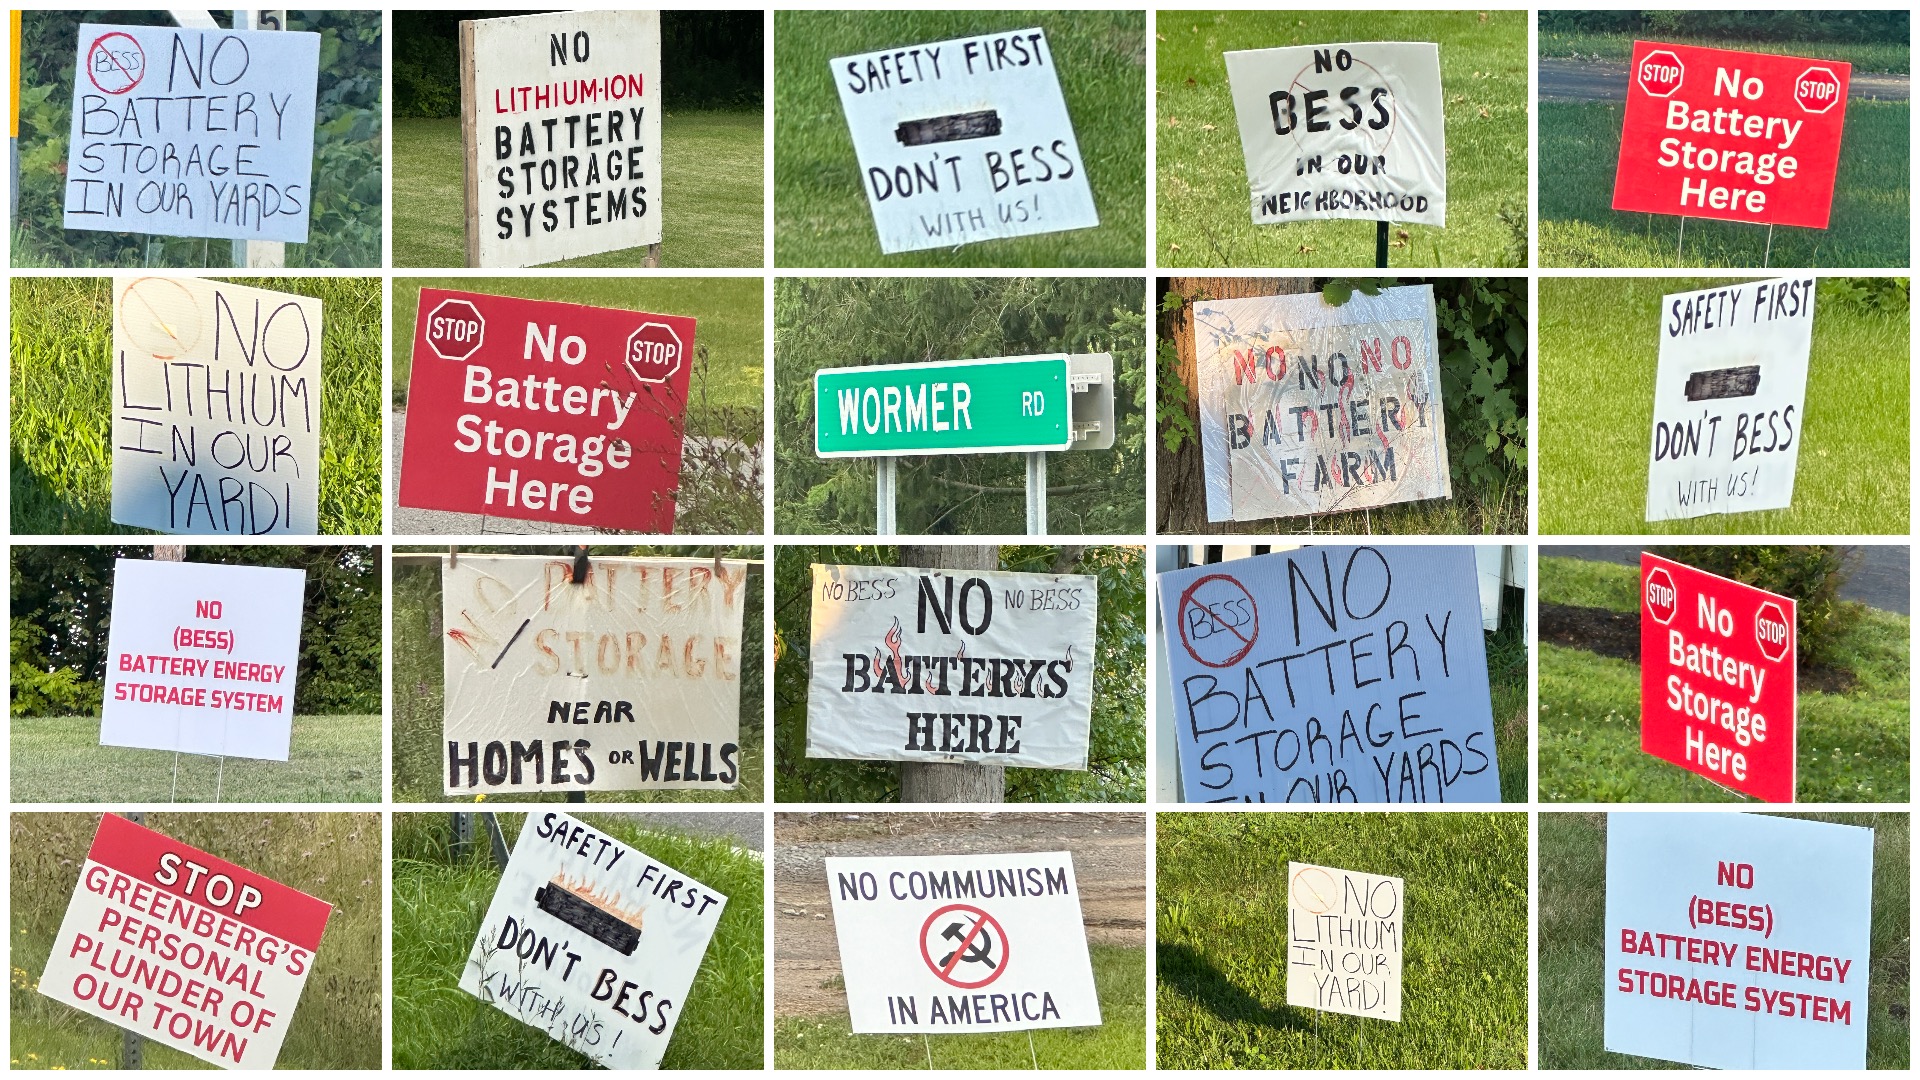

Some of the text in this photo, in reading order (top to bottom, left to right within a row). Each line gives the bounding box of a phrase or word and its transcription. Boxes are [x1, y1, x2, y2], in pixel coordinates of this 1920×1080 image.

[95, 49, 141, 74] BESS
[168, 33, 249, 91] NO
[550, 31, 590, 67] NO
[846, 33, 1044, 94] SAFETY FIRST
[1313, 49, 1353, 75] NO
[1643, 62, 1679, 84] STOP
[1713, 66, 1764, 101] No
[1799, 79, 1835, 100] STOP
[81, 94, 293, 140] BATTERY
[495, 108, 645, 160] BATTERY
[1268, 87, 1393, 136] BESS
[1665, 101, 1803, 150] Battery
[80, 144, 269, 178] STORAGE
[497, 147, 645, 200] STORAGE
[868, 139, 1076, 202] DON'T BESS
[1296, 154, 1387, 176] IN OUR
[1657, 138, 1798, 186] Storage
[67, 179, 301, 231] IN OUR YARDS
[496, 187, 648, 241] SYSTEMS
[919, 199, 1042, 239] WITH US!
[1260, 190, 1429, 216] NEIGHBORHOOD
[1680, 176, 1766, 213] Here
[214, 290, 310, 373] NO
[432, 317, 479, 343] STOP
[1668, 278, 1814, 338] SAFETY FIRST
[522, 321, 587, 367] No
[632, 338, 676, 366] STOP
[1233, 335, 1412, 391] NO NO NO
[120, 350, 311, 433] LITHIUM
[463, 365, 637, 431] Battery
[837, 379, 1045, 437] WORMER RD
[454, 413, 632, 477] Storage
[1228, 392, 1430, 450] BATTERY
[1655, 404, 1795, 462] DON'T BESS
[120, 416, 300, 478] IN OUR
[1279, 447, 1397, 495] FARM
[484, 465, 594, 516] Here
[1677, 466, 1758, 507] WITH US!
[195, 600, 223, 620] NO
[821, 578, 898, 602] NO BESS
[915, 575, 993, 637] NO
[1003, 588, 1083, 612] NO BESS
[1287, 546, 1391, 647] NO
[1649, 583, 1674, 609] STOP
[1188, 598, 1251, 641] BESS
[1697, 592, 1734, 638] No
[1759, 619, 1786, 646] STOP
[172, 625, 235, 655] (BESS)
[533, 628, 738, 681] STORAGE
[119, 653, 286, 685] BATTERY ENERGY
[841, 653, 1072, 700] BATTERYS
[1182, 611, 1452, 743] BATTERY
[1668, 630, 1765, 704] Battery
[114, 682, 283, 715] STORAGE SYSTEM
[547, 700, 635, 725] NEAR
[1667, 675, 1767, 747] Storage
[905, 711, 1021, 754] HERE
[1199, 692, 1443, 789] STORAGE
[1685, 726, 1748, 782] Here
[448, 738, 739, 788] HOMES OR WELLS
[1373, 732, 1489, 803] YARDS
[153, 853, 263, 918] STOP
[536, 812, 719, 916] SAFETY FIRST
[837, 866, 1070, 902] NO COMMUNISM
[1717, 861, 1754, 890] NO
[1344, 874, 1397, 919] NO
[1688, 894, 1775, 939] (BESS)
[84, 866, 306, 977] GREENBERG'S
[1292, 908, 1398, 953] LITHIUM
[98, 907, 266, 1000] PERSONAL
[497, 915, 672, 1035] DON'T BESS
[1292, 945, 1391, 978] IN OUR
[1621, 929, 1852, 984] BATTERY ENERGY
[69, 932, 277, 1035] PLUNDER OF
[888, 991, 1062, 1025] IN AMERICA
[1313, 972, 1386, 1013] YARD!
[1617, 967, 1852, 1026] STORAGE SYSTEM
[71, 972, 249, 1064] OUR TOWN
[500, 973, 623, 1058] WITH US!
